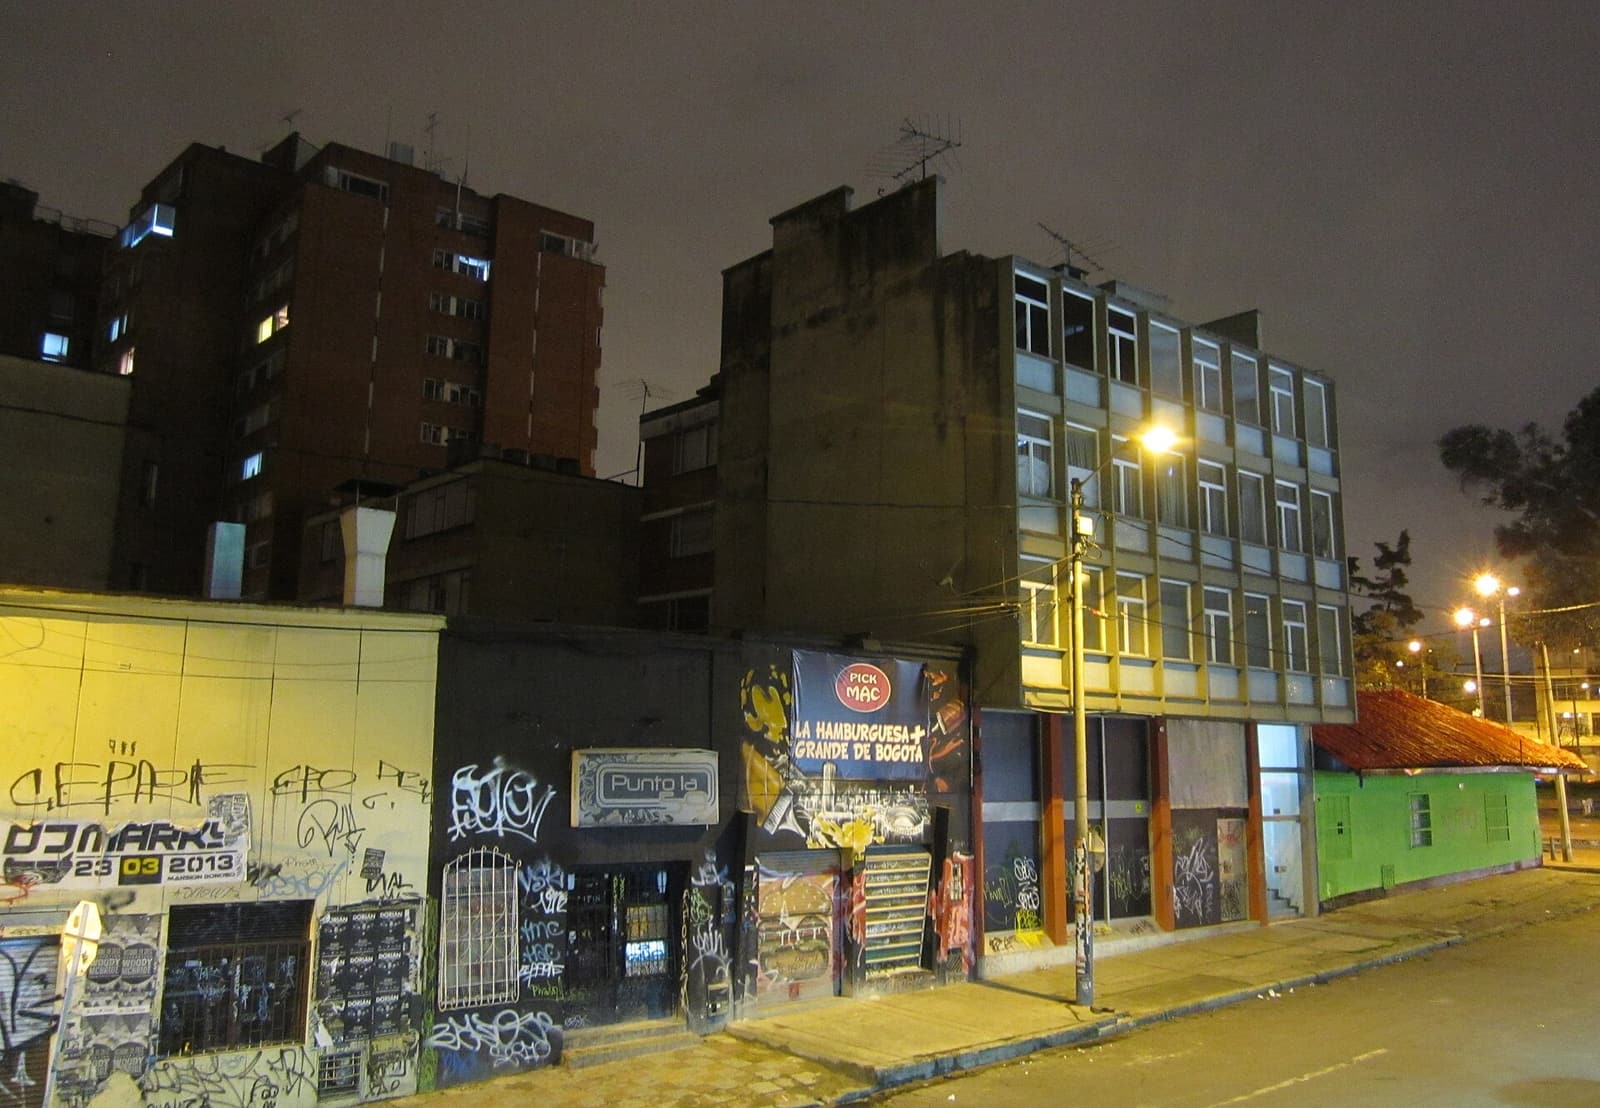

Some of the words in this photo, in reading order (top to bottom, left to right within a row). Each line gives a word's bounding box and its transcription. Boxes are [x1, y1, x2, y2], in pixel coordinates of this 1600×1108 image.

[849, 673, 877, 685] PICK
[846, 686, 880, 702] MAC
[796, 721, 811, 739] LA
[795, 741, 849, 759] GRANDE
[854, 744, 871, 760] DE
[611, 774, 675, 792] Punto
[680, 775, 698, 792] la
[75, 860, 112, 877] 23
[123, 858, 160, 875] 03
[169, 855, 234, 873] 2013
